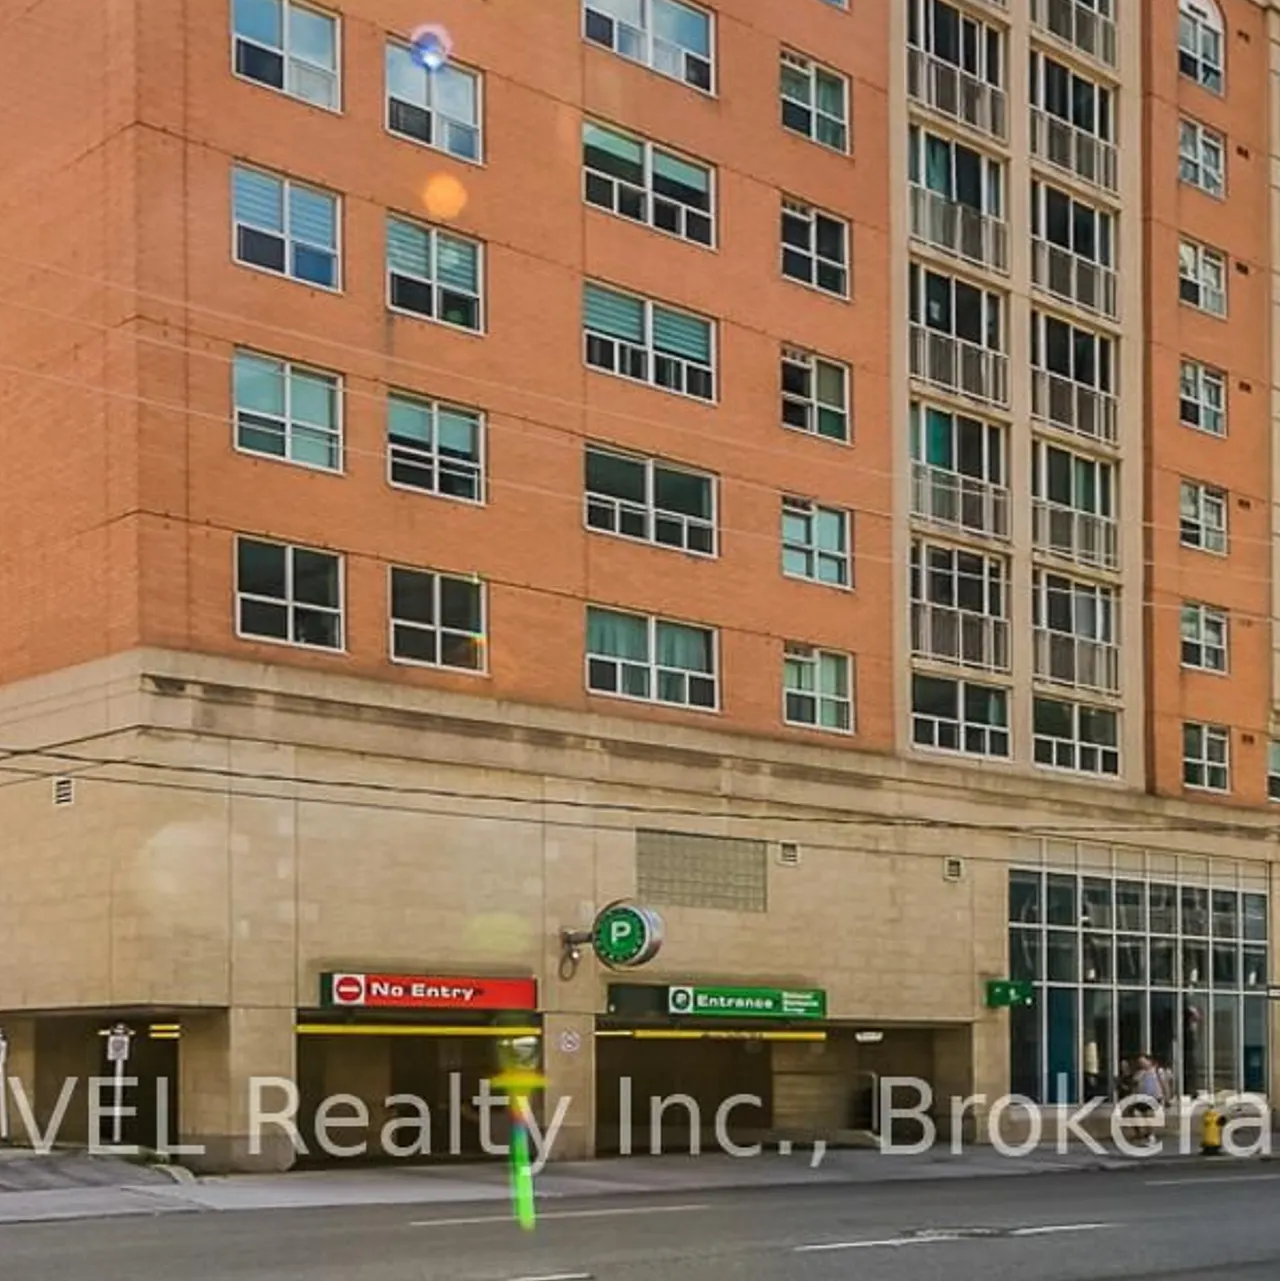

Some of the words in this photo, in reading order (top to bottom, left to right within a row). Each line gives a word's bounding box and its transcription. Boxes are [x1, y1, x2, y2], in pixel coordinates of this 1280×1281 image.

[611, 921, 631, 944] P
[371, 981, 404, 997] No
[411, 983, 474, 1001] Entry
[696, 994, 774, 1010] Entrance
